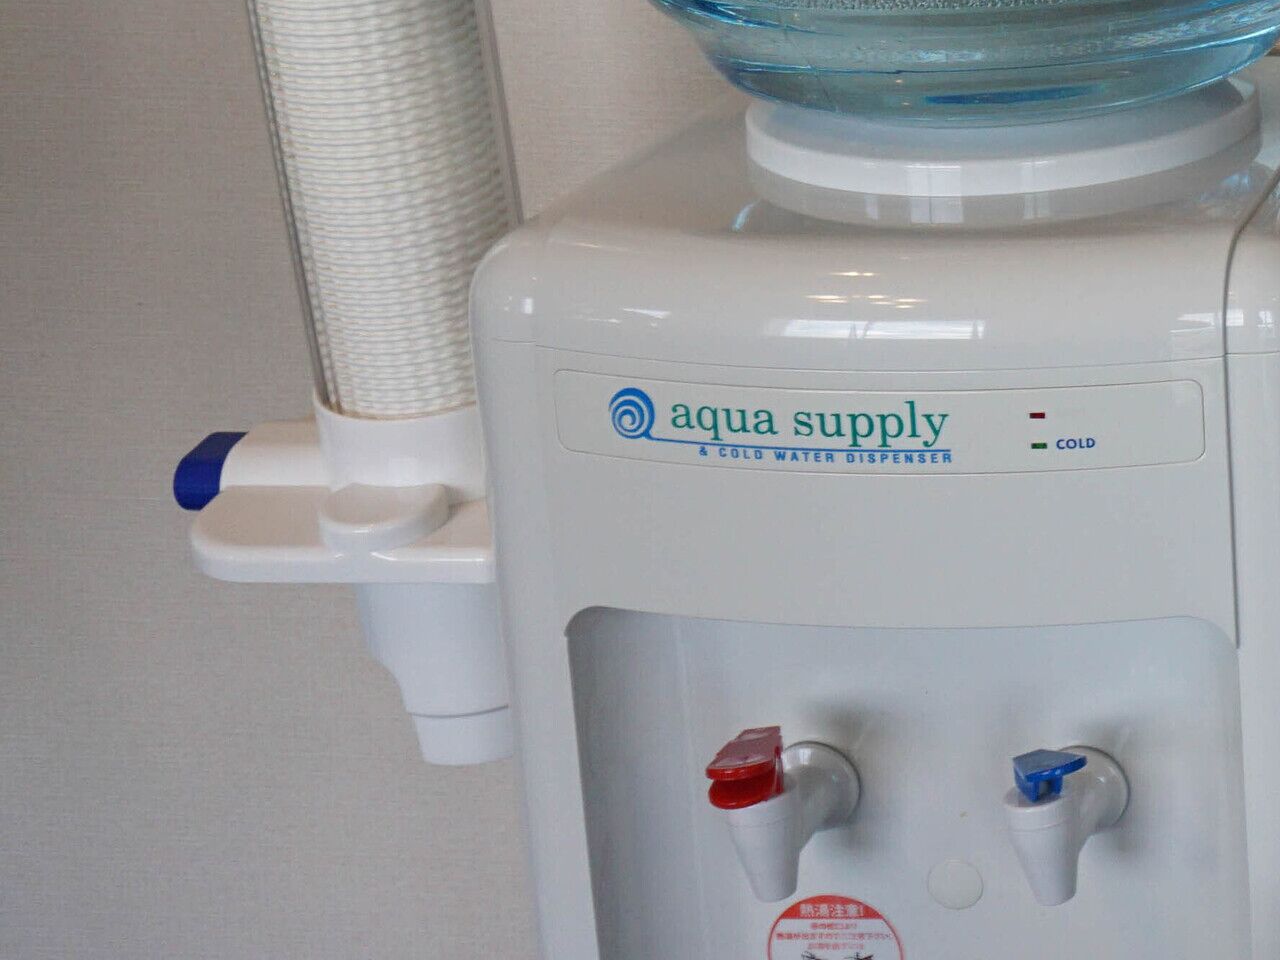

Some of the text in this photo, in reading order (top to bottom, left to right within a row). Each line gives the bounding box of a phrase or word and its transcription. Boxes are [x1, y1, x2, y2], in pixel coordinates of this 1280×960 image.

[671, 401, 949, 447] aqua supply
[1055, 437, 1096, 450] COLD
[700, 445, 953, 464] & COLD WATER DISPENSER
